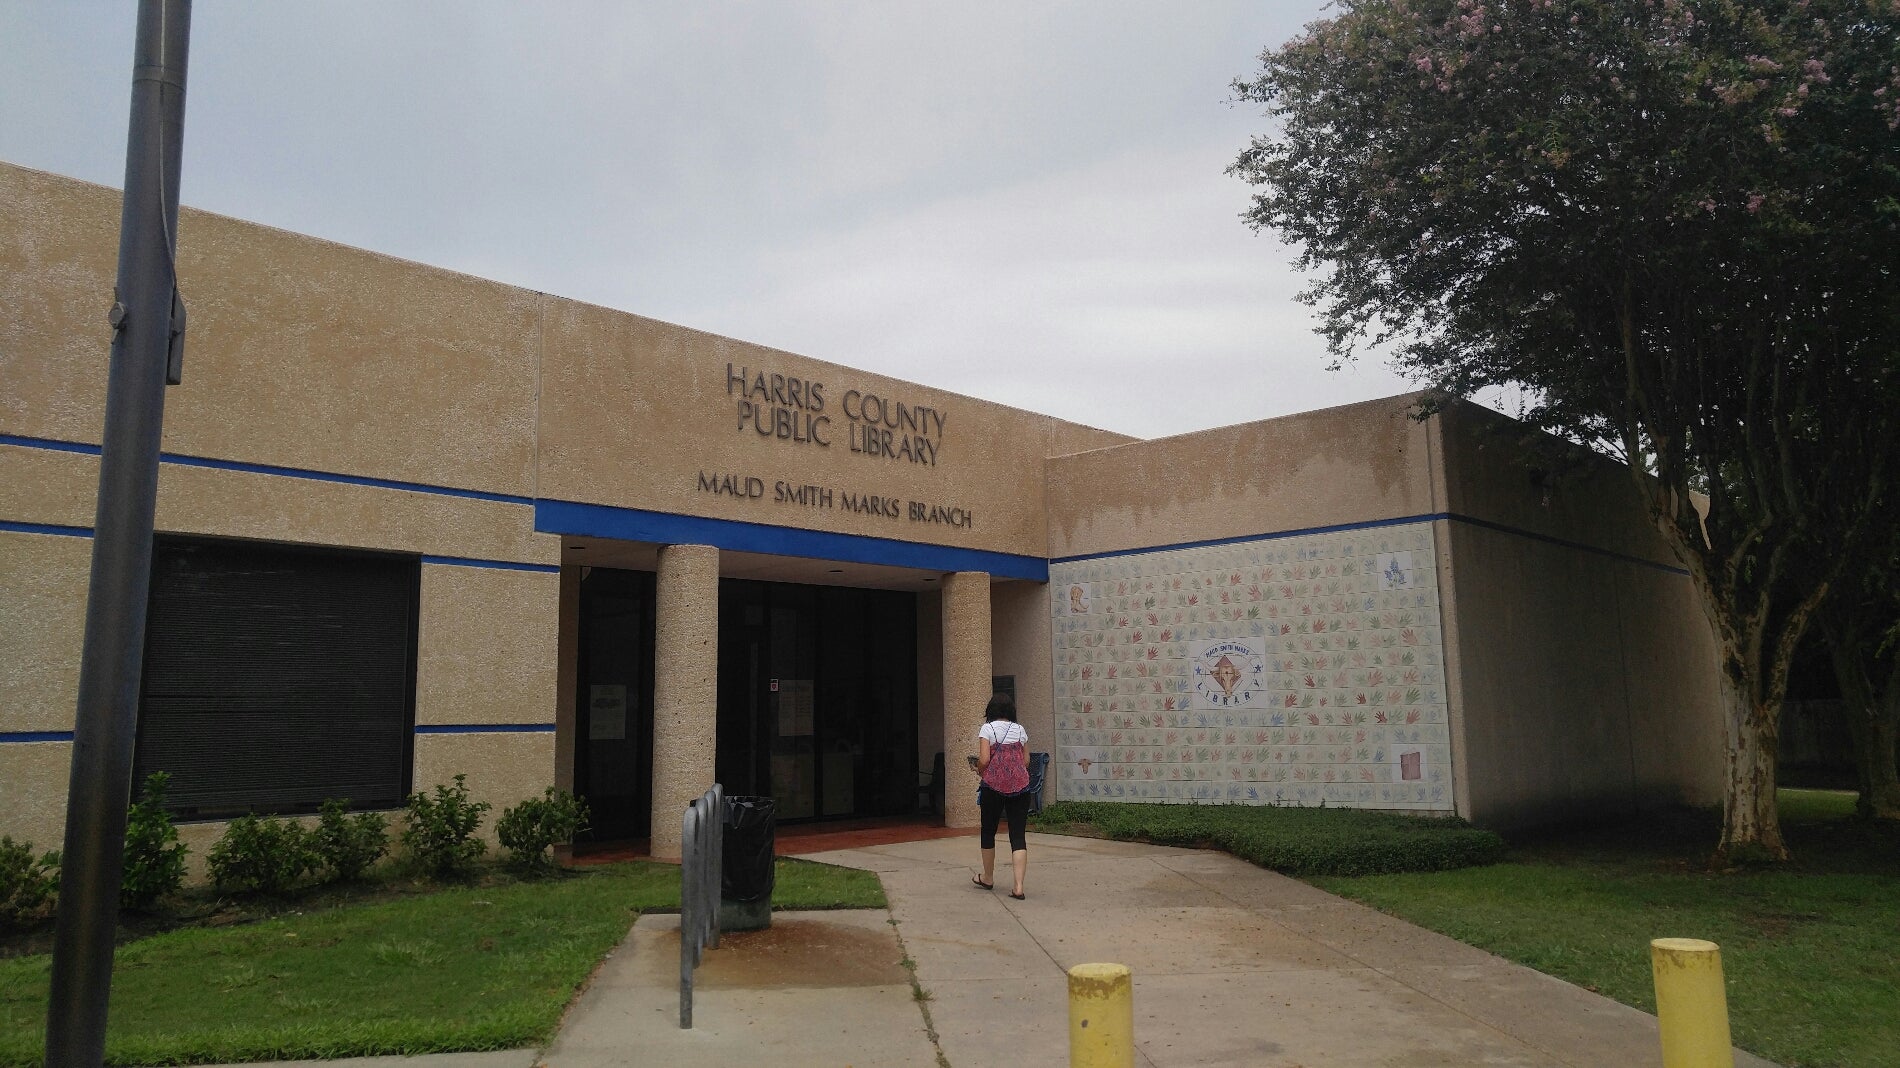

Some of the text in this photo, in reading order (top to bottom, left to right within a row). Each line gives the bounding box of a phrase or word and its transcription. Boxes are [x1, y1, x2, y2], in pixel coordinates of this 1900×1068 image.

[727, 362, 947, 437] HARRIS COUNTY
[737, 399, 942, 466] PUBLIC LIBRARY
[697, 469, 972, 528] MAUD SMITH MARKS BRANCH
[1197, 679, 1260, 706] LIBRARY
